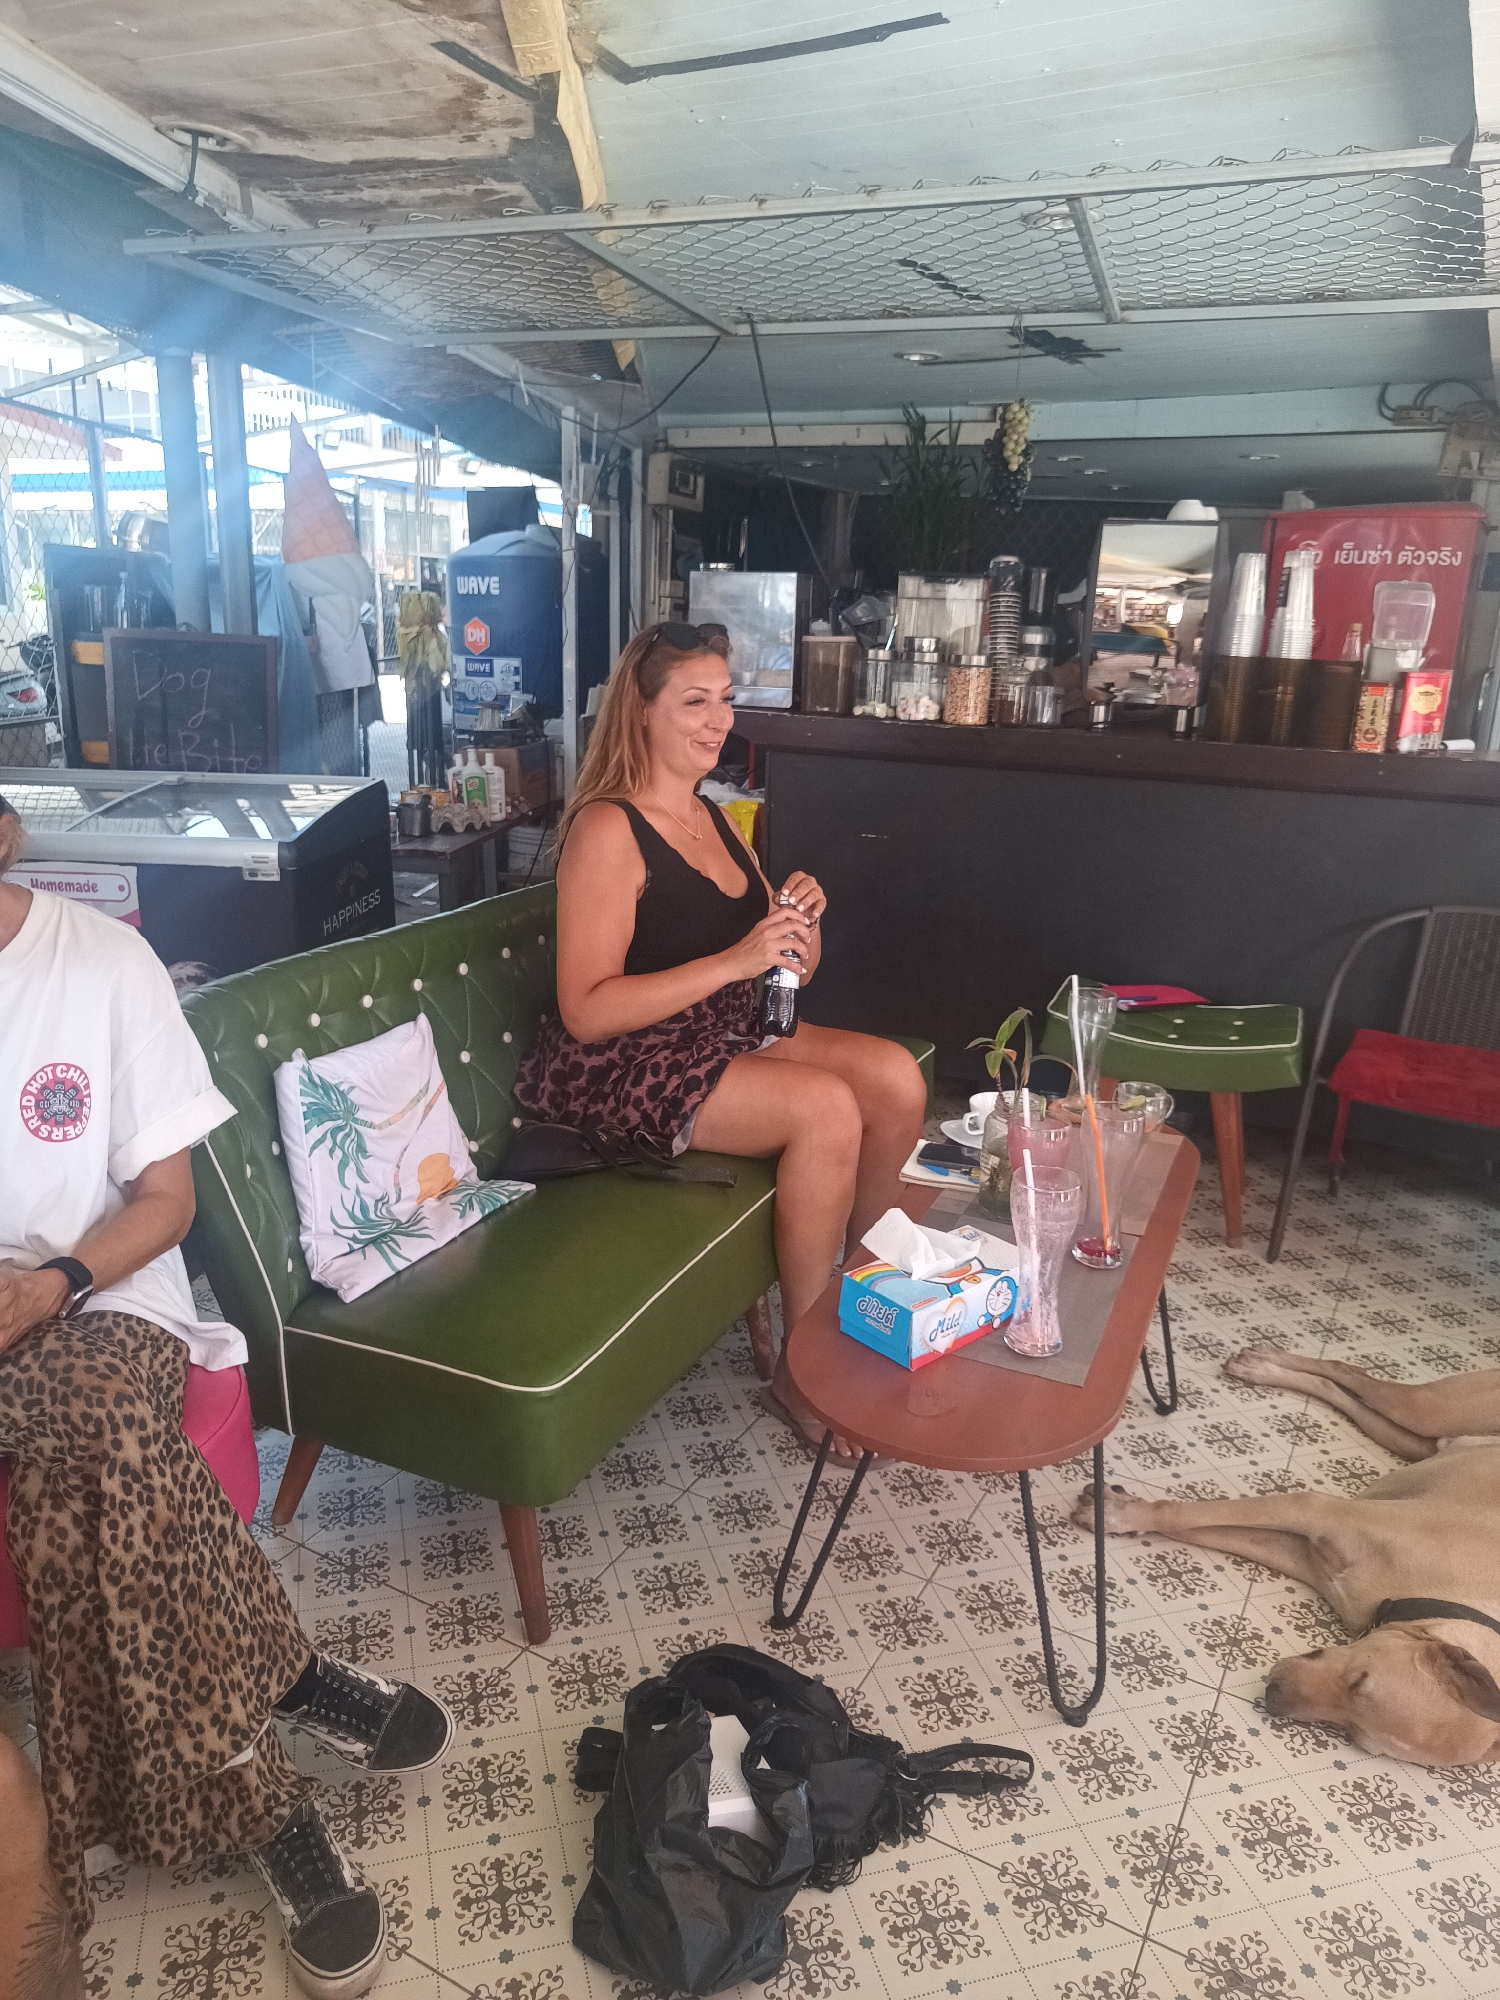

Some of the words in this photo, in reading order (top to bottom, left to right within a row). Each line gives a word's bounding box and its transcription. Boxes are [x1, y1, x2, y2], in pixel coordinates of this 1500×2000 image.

[1397, 545, 1462, 567] ตัวจริง
[456, 575, 500, 595] WAVE
[467, 627, 486, 643] DH
[467, 662, 491, 673] WAVE
[30, 878, 99, 893] Homemade
[323, 888, 381, 936] HAPPINESS
[26, 1065, 54, 1094] HOT
[55, 1064, 90, 1096] CHILI
[21, 1095, 41, 1131] RED
[38, 1097, 91, 1140] PEPPERS
[928, 1311, 962, 1343] Mild
